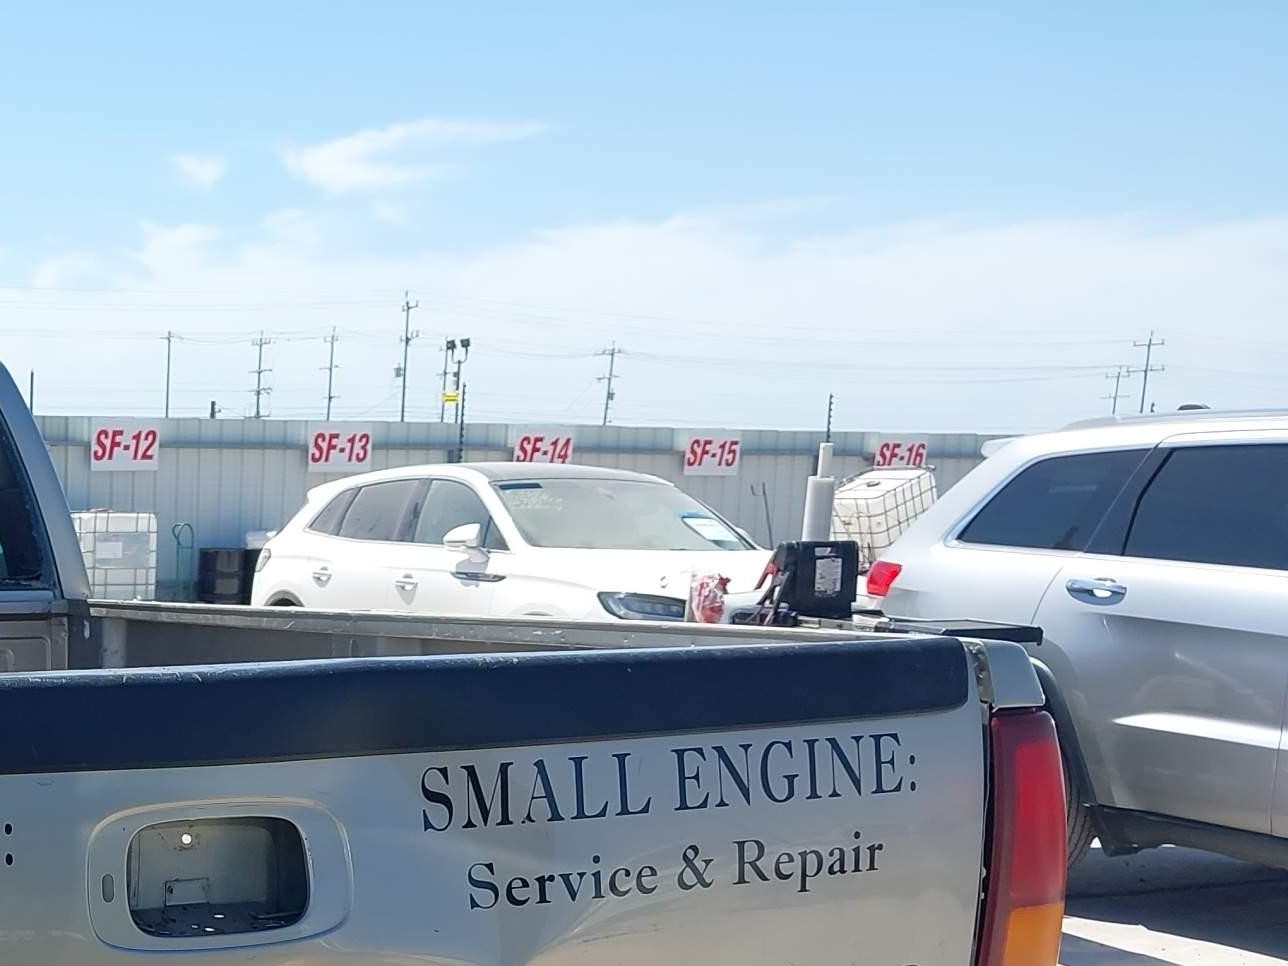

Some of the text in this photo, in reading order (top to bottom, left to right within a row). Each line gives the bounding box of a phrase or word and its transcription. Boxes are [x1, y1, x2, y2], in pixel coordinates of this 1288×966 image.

[94, 429, 158, 461] SF-12
[312, 432, 370, 463] SF-13
[516, 436, 572, 463] SF-14
[686, 439, 739, 467] SF-15
[877, 442, 926, 466] SF-16
[421, 732, 918, 833] SMALL ENGINE:
[468, 830, 884, 910] Service & Repair
